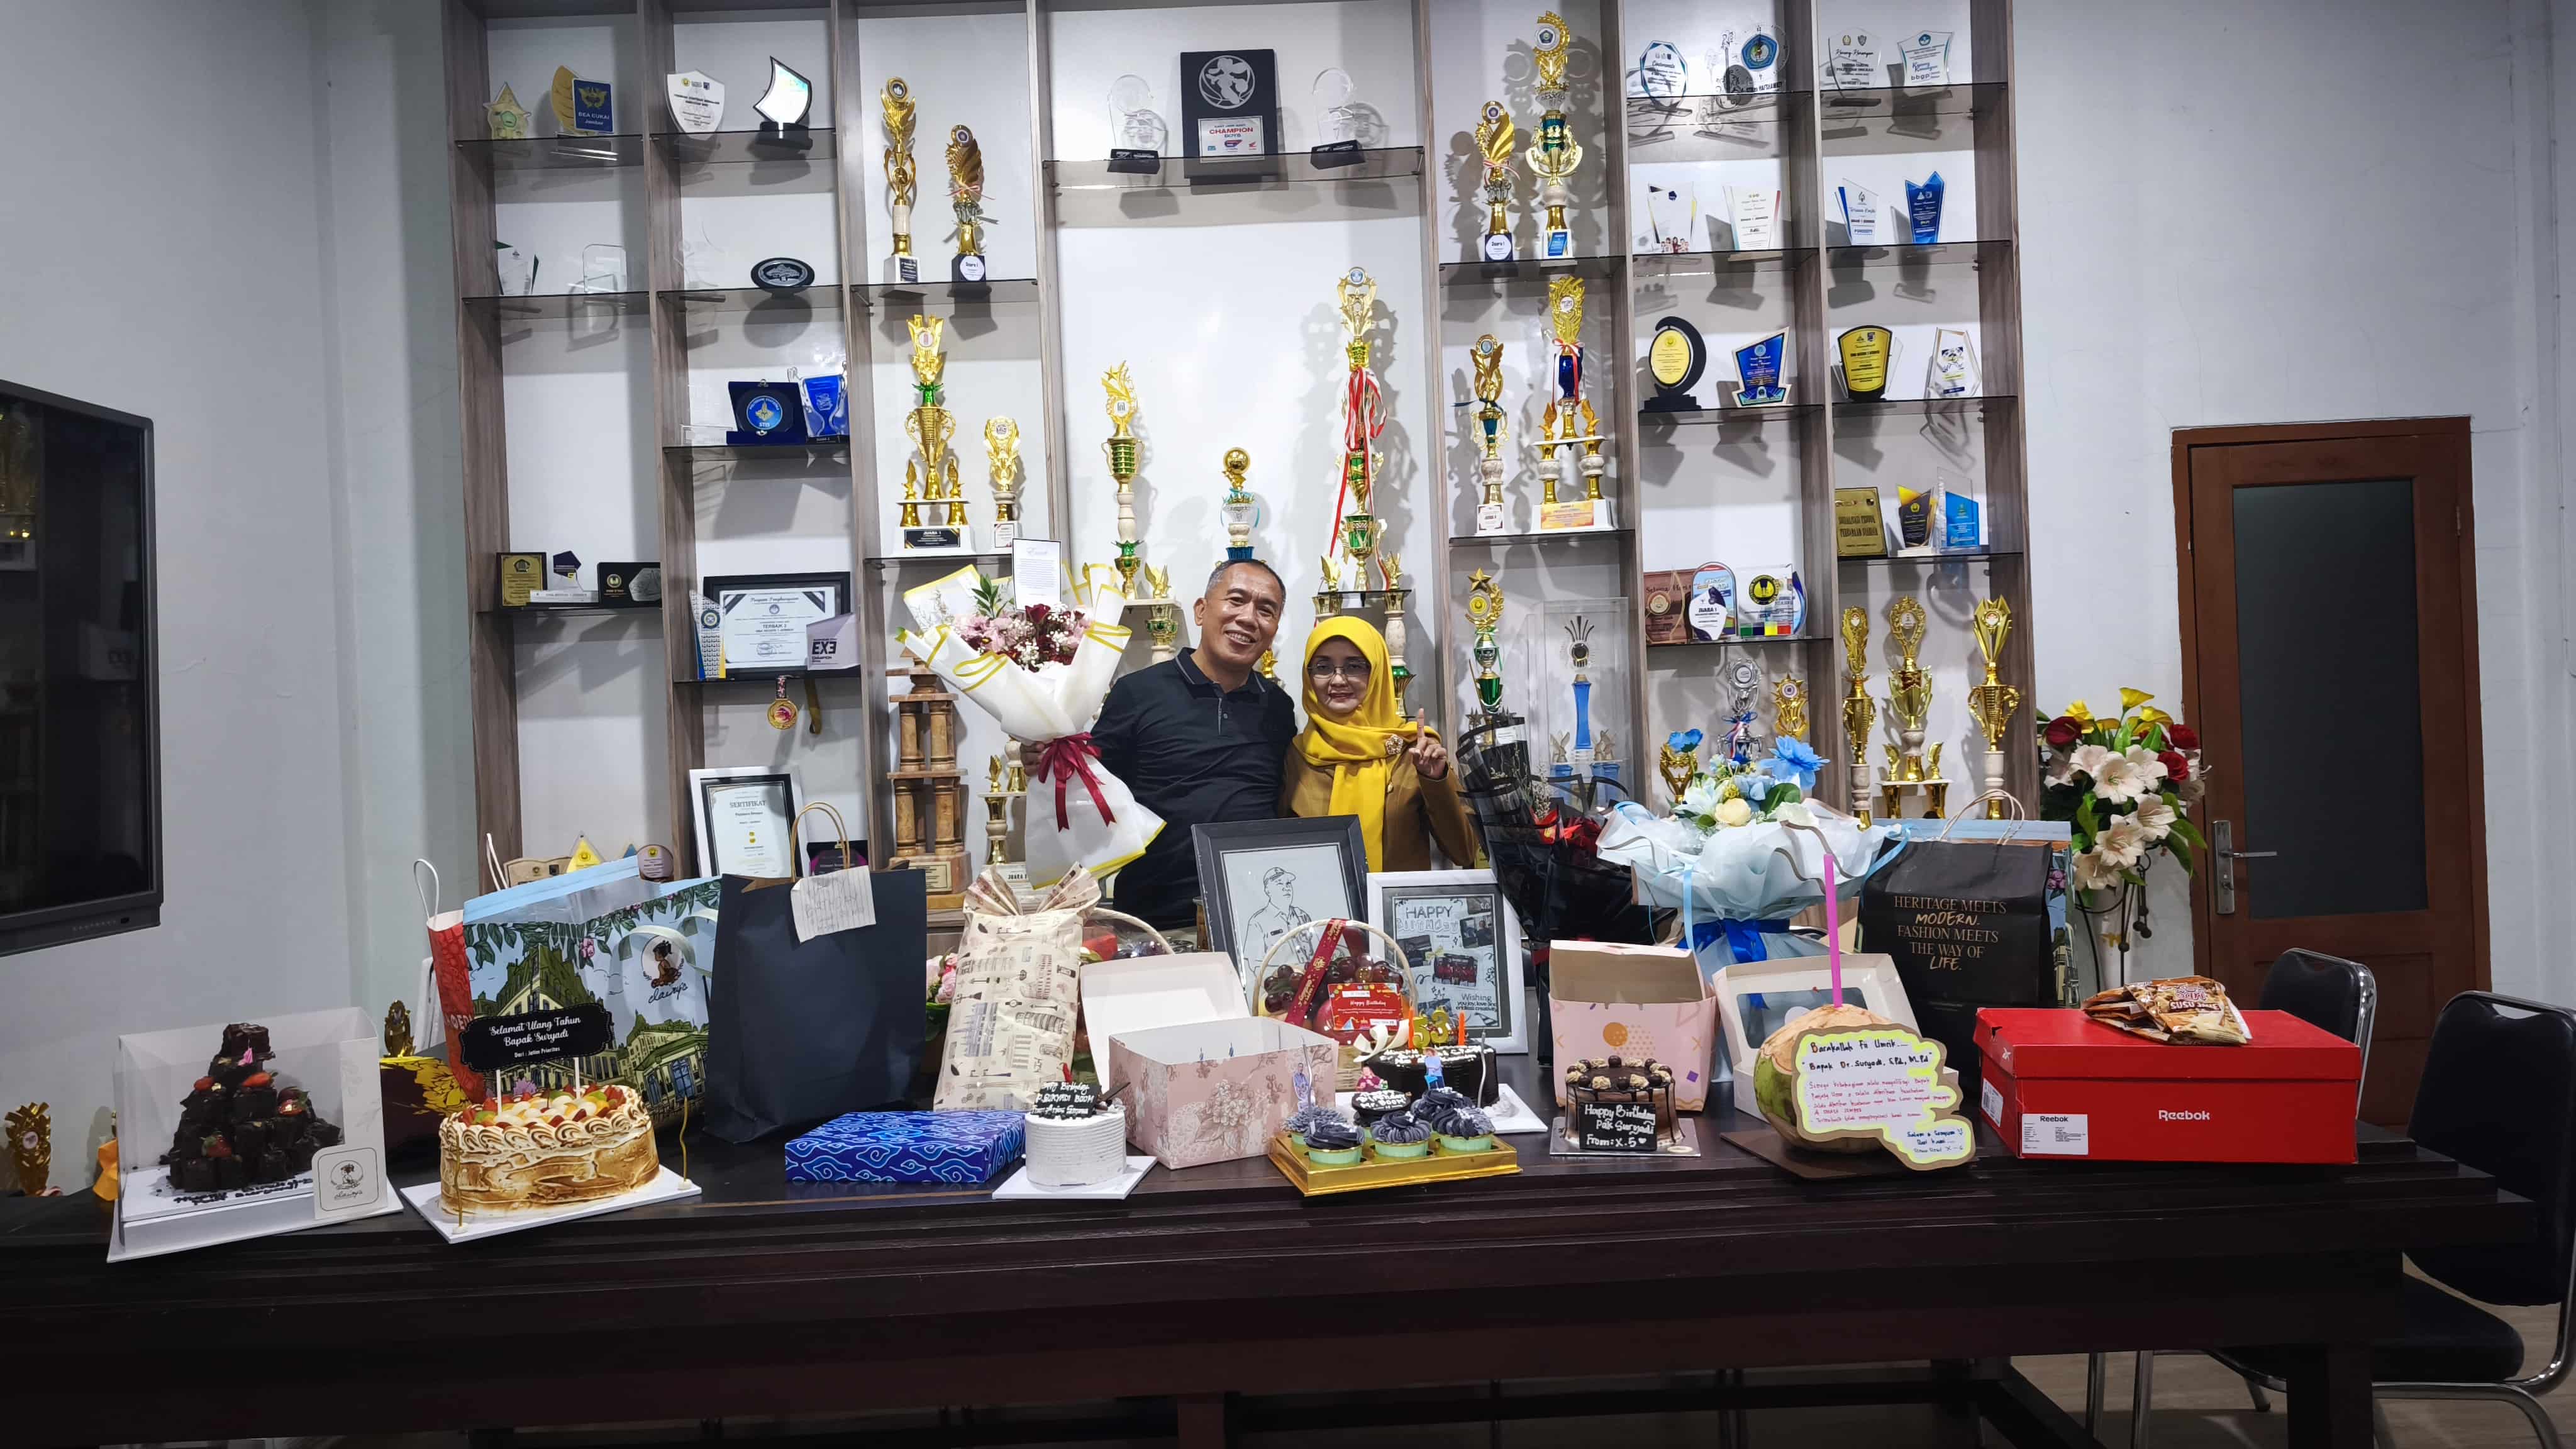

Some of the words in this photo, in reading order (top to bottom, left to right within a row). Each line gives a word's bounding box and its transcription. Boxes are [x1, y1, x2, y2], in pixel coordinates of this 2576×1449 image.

[730, 800, 766, 808] SERTIFIKAT
[1406, 905, 1453, 919] HAPPY
[1894, 895, 1958, 911] HERITAGE
[1962, 899, 2007, 914] MEETS
[1915, 911, 1980, 926] MODERN.
[1898, 925, 1950, 940] FASHION
[1953, 929, 1999, 943] MEETS
[1910, 941, 1934, 955] THE
[1938, 943, 1963, 957] WAY
[1967, 945, 1985, 958] OF
[1929, 955, 1962, 970] LIFE.
[1461, 993, 1492, 1002] Wishing
[2170, 1001, 2195, 1010] SUSU
[489, 1023, 525, 1036] Selamat
[526, 1019, 553, 1031] Ulang
[554, 1016, 581, 1028] Tahun
[504, 1034, 533, 1046] Bapak
[535, 1029, 569, 1043] Suryadi
[1585, 1104, 1614, 1121] Happy
[1616, 1104, 1655, 1126] Birthday
[2158, 1109, 2210, 1121] Reebok
[1596, 1119, 1614, 1130] Pak
[1614, 1120, 1655, 1135] Suryadi
